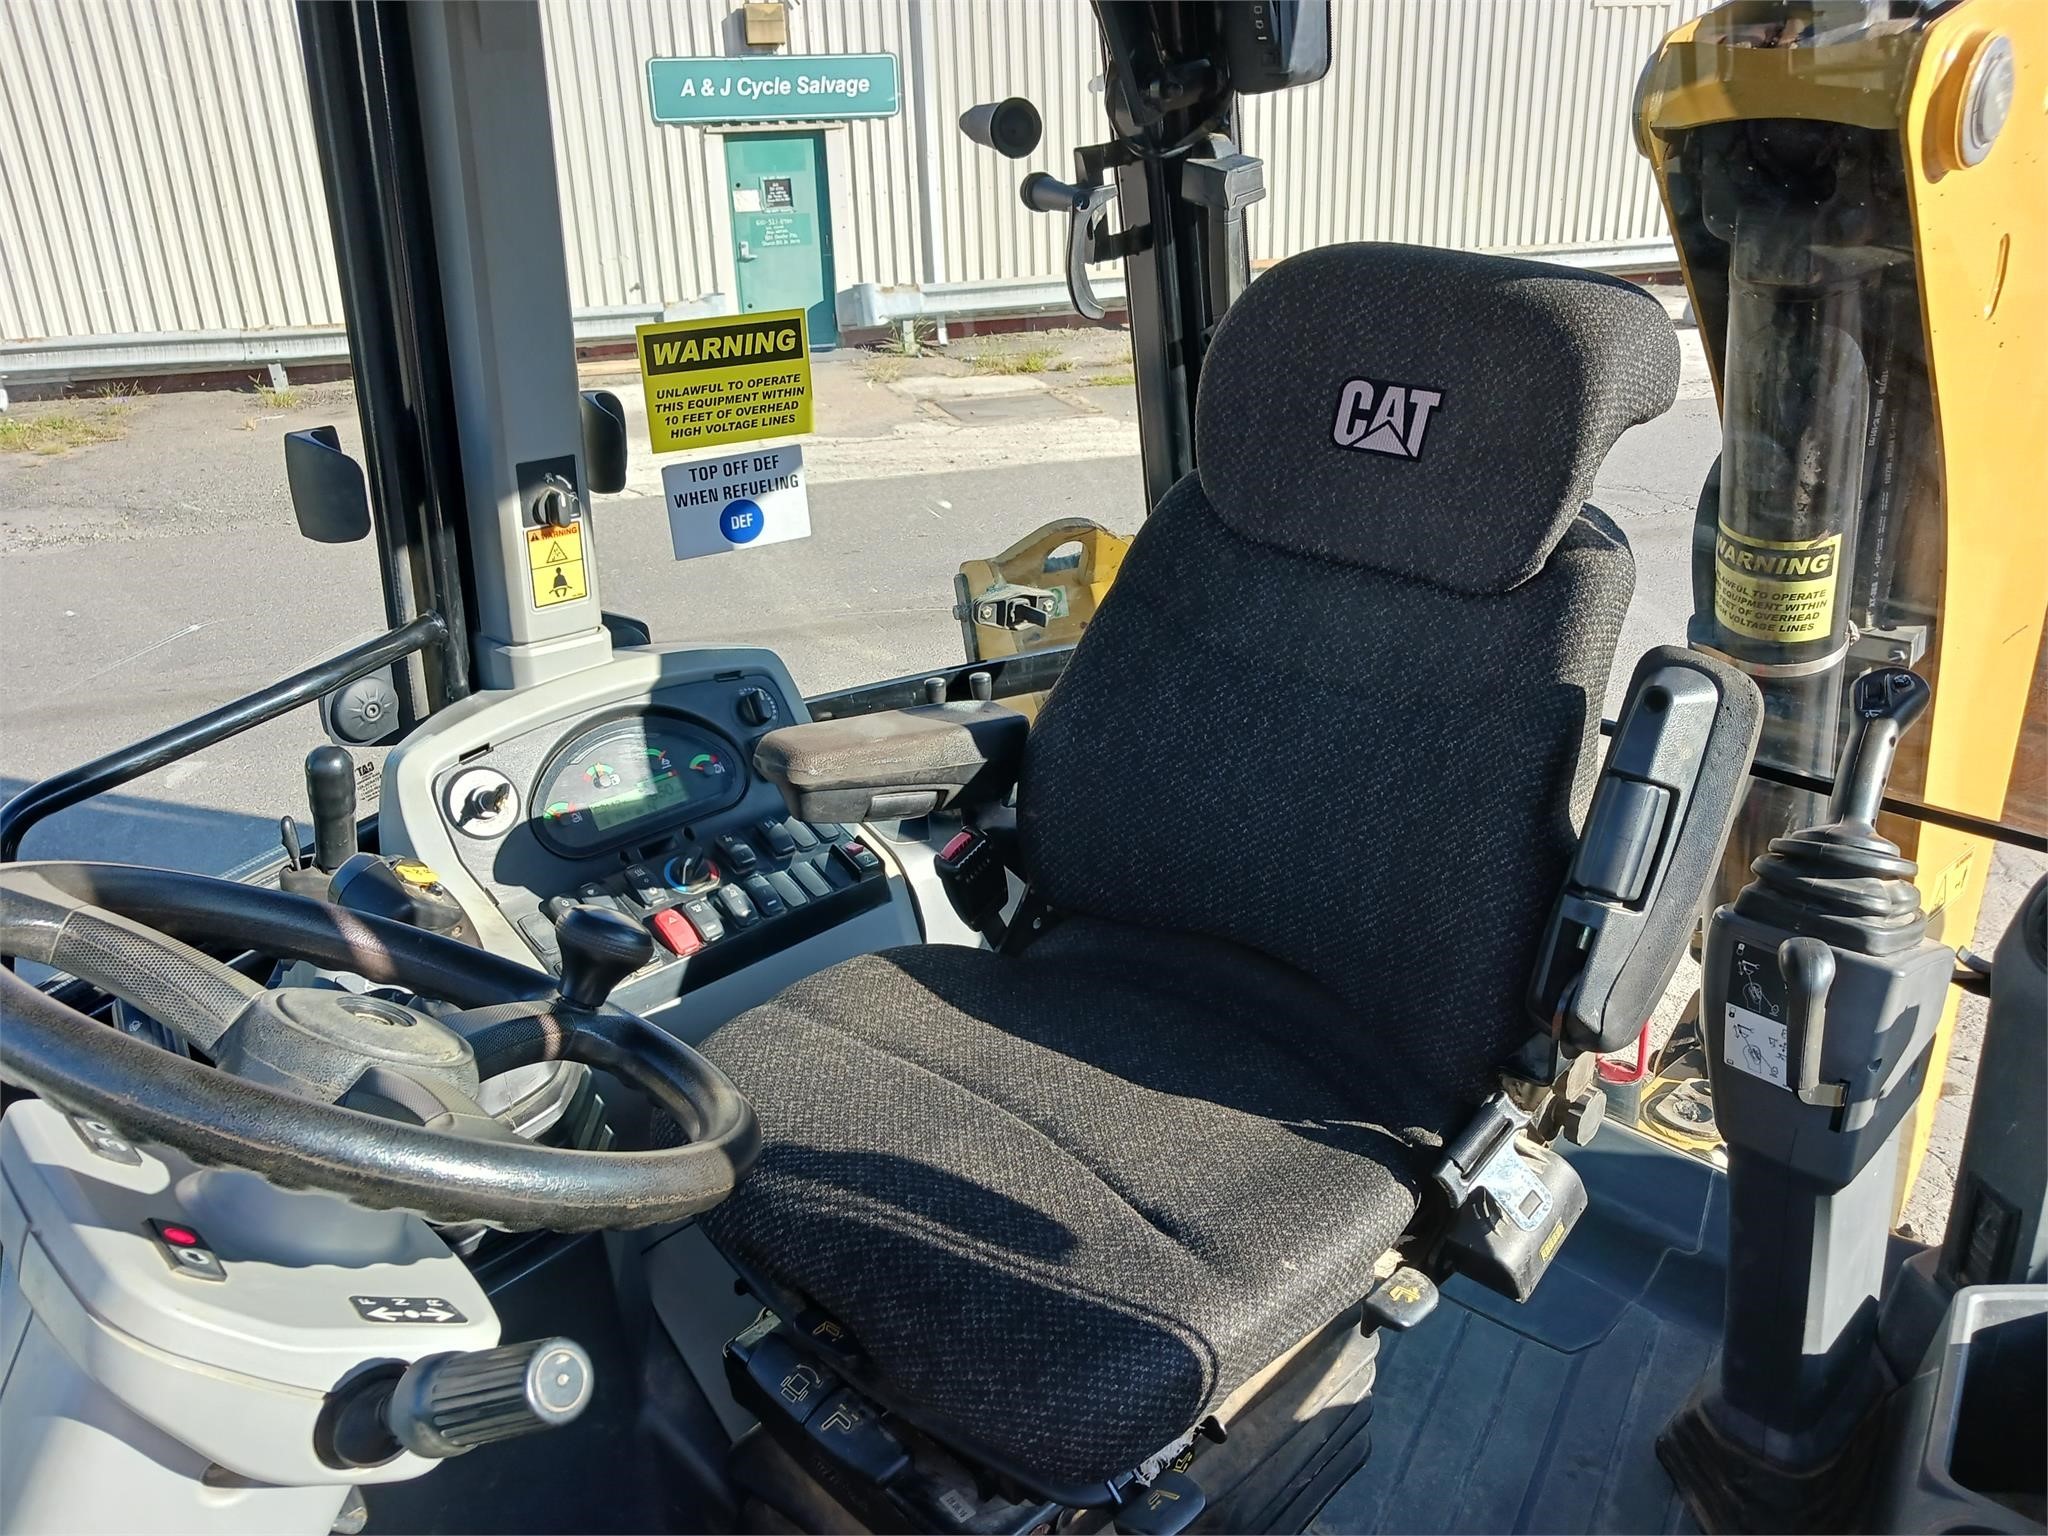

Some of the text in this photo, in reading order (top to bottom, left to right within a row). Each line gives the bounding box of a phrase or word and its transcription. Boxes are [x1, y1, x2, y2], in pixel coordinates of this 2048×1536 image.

[680, 75, 870, 100] A & J Cycle Salvage
[652, 328, 797, 366] WARNING
[656, 373, 801, 400] UNLAWFUL TO OPERATE
[655, 386, 806, 414] THIS EQUIPMENT WITHIN
[665, 400, 800, 426] 10 FEET OF OVERHEAD
[1333, 379, 1442, 459] CAT
[670, 414, 796, 439] HIGH VOLTAGE LINES
[688, 454, 779, 483] TOP OFF DEF
[674, 474, 800, 509] WHEN REFUELING
[541, 527, 577, 540] WARNING
[730, 512, 754, 530] DEF
[1722, 587, 1784, 612] EQUIPMENT
[1785, 599, 1829, 612] WITHIN
[1753, 589, 1769, 600] TO
[1771, 588, 1828, 601] OPERATE
[1728, 611, 1815, 633] VOLTAGE LINES
[1738, 606, 1753, 617] OF
[1754, 611, 1821, 623] OVERHEAD
